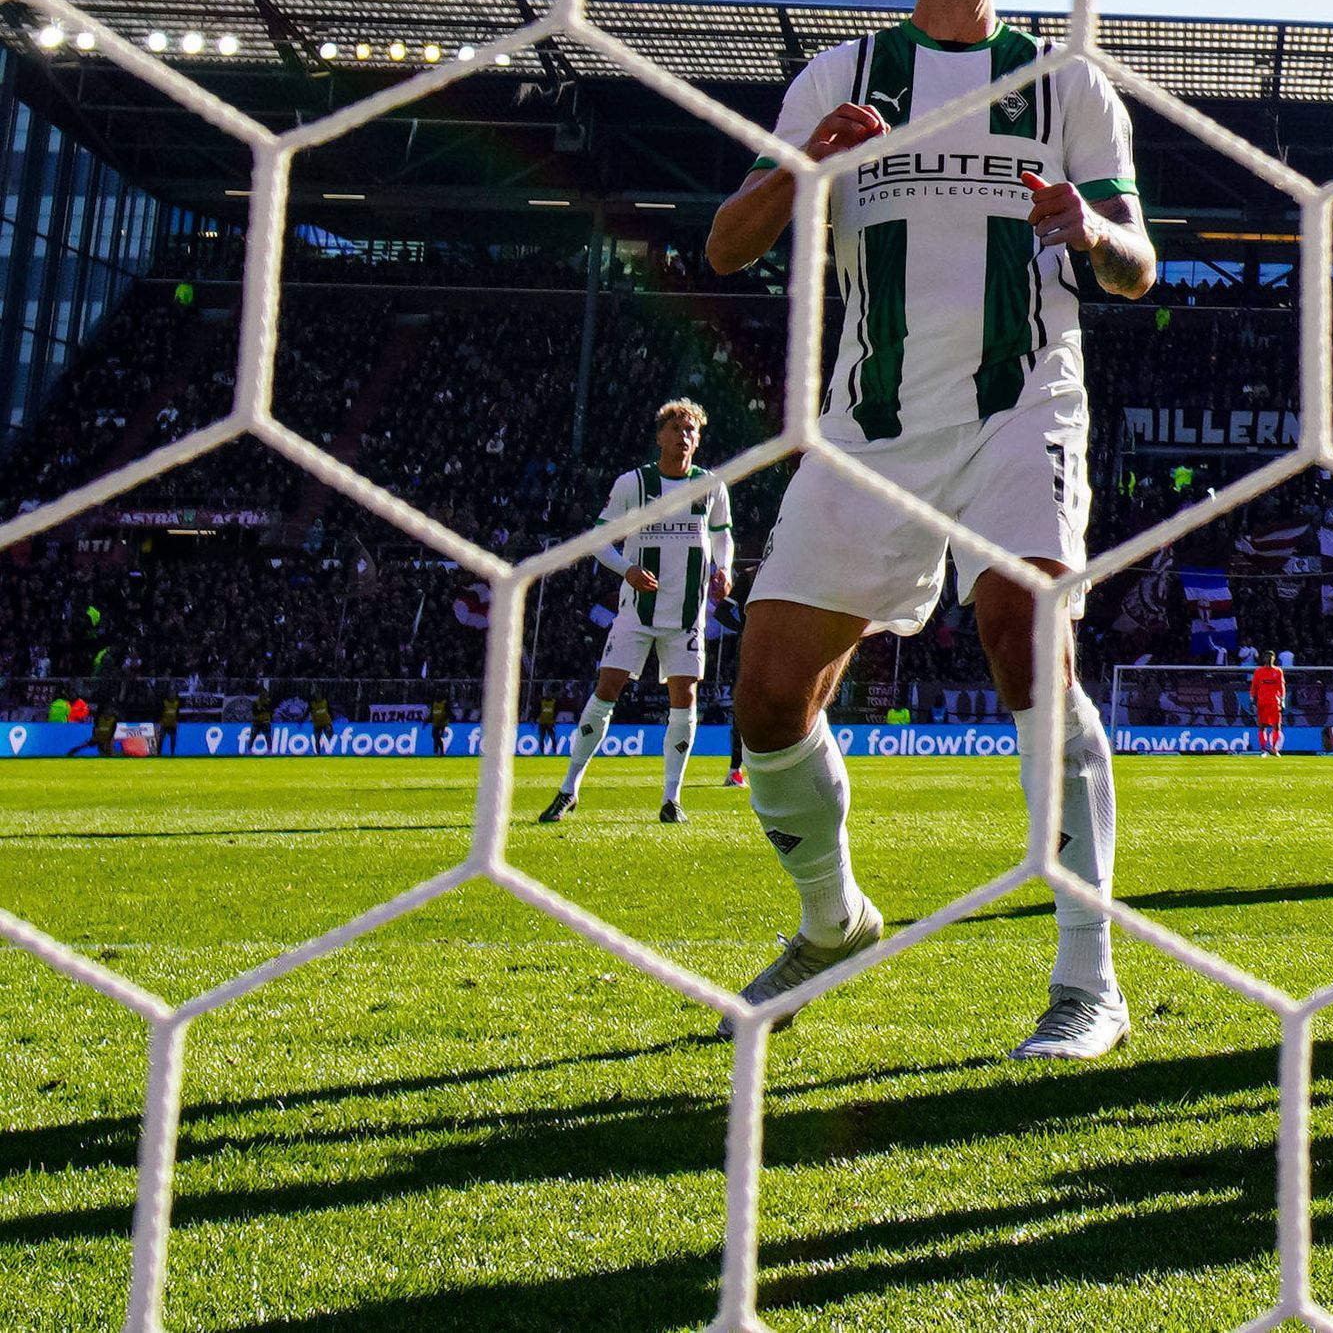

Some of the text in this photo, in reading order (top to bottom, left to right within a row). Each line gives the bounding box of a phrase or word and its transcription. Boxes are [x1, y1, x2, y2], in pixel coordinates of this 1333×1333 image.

[858, 153, 1044, 184] REUTER
[935, 186, 1030, 201] LEUCHTE
[640, 523, 698, 532] REUTE
[868, 728, 1020, 756] followfoo
[1116, 730, 1250, 751] llowfood
